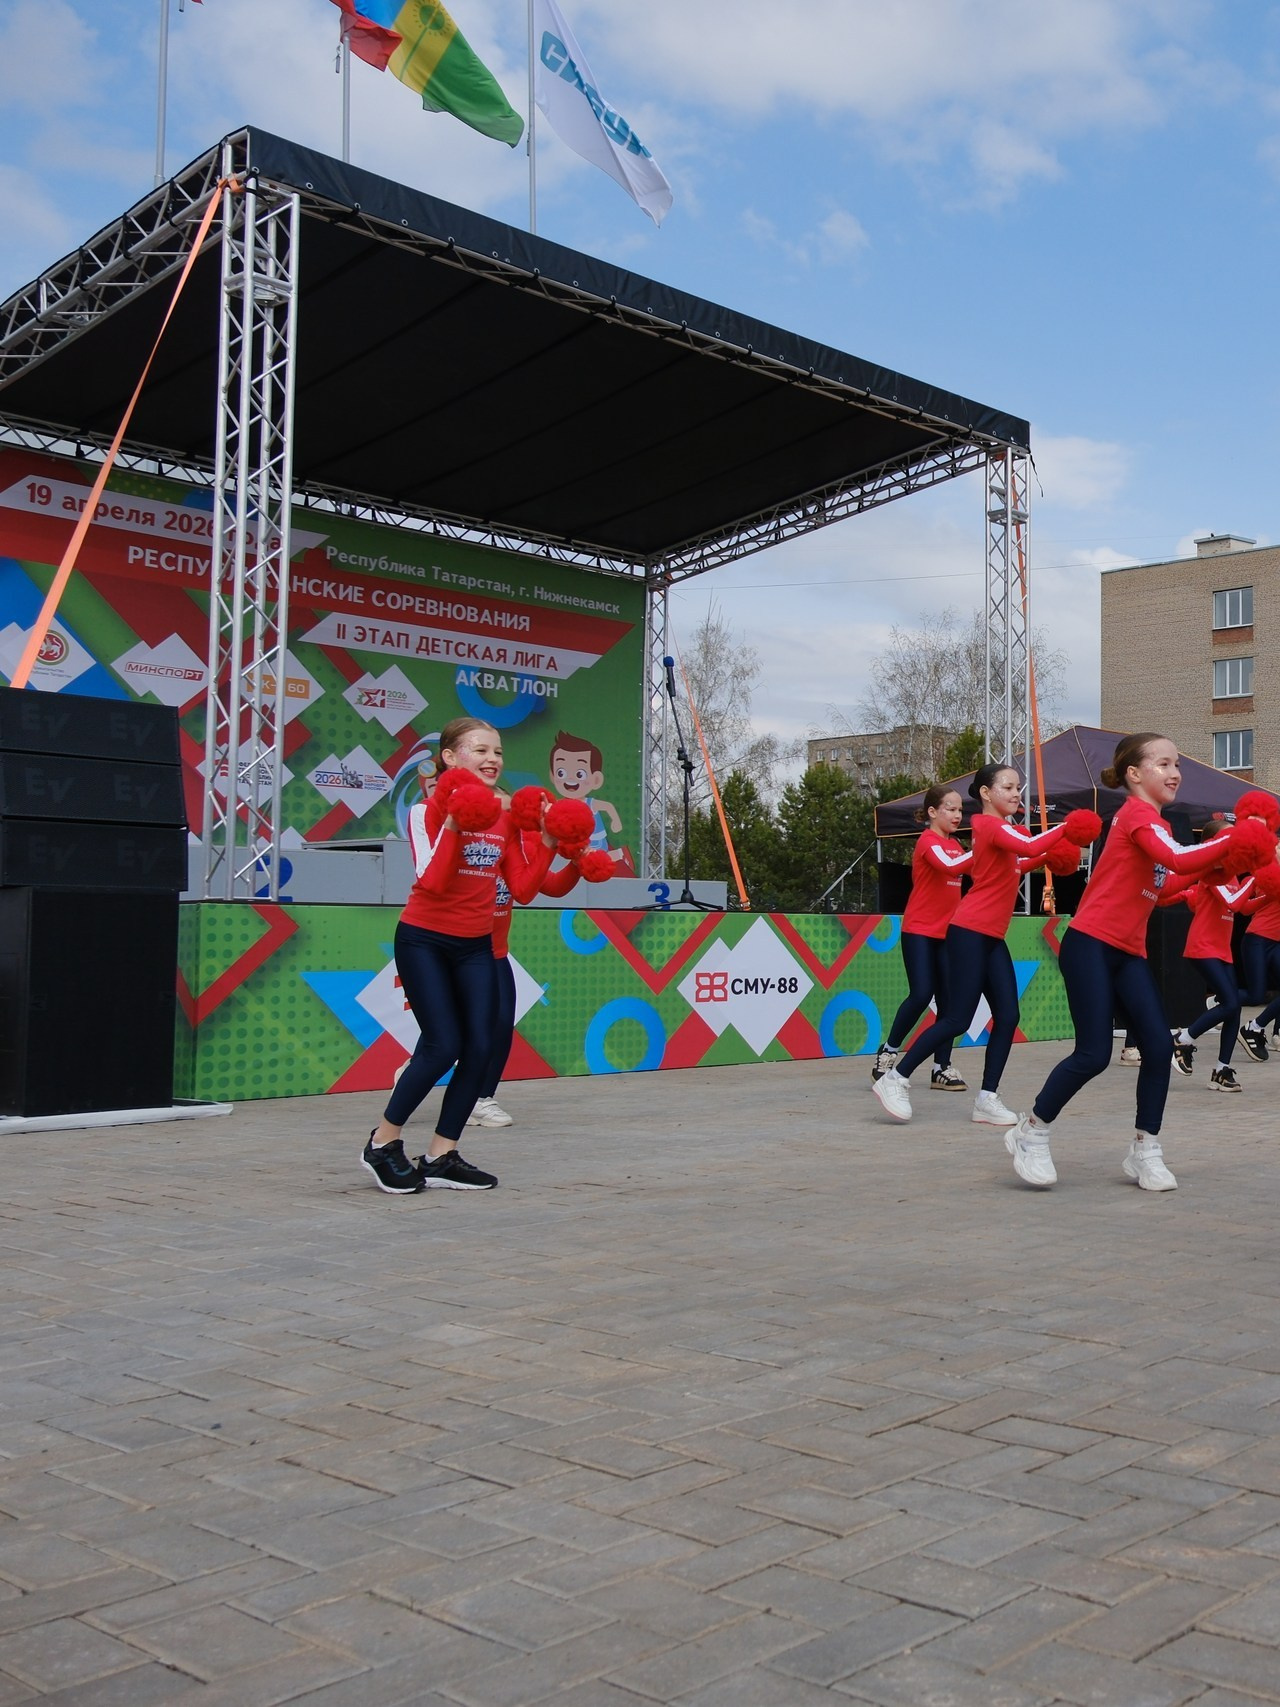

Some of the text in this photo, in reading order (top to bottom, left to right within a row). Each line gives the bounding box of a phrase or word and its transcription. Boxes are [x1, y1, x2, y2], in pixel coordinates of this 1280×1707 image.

[26, 482, 51, 505] 19
[227, 529, 281, 551] гоа
[128, 545, 530, 631] РЕСПУЛКНСКИЕ СОРЕВНОВАНИЯ
[326, 546, 620, 614] Республика Татарстан, г. Нижнекамск
[354, 626, 410, 649] ЭТАП
[416, 635, 507, 664] ДЕТСКАЯ
[513, 651, 558, 671] ЛИГА
[127, 663, 202, 680] МИНСПОРТ
[456, 670, 558, 698] АКВАТЛОН
[387, 690, 407, 699] 2026
[315, 773, 341, 784] 2026
[463, 844, 501, 857] Ice Club
[471, 855, 493, 866] Kids
[254, 853, 294, 902] 2
[647, 882, 671, 911] 3
[731, 977, 798, 995] СМУ-88
